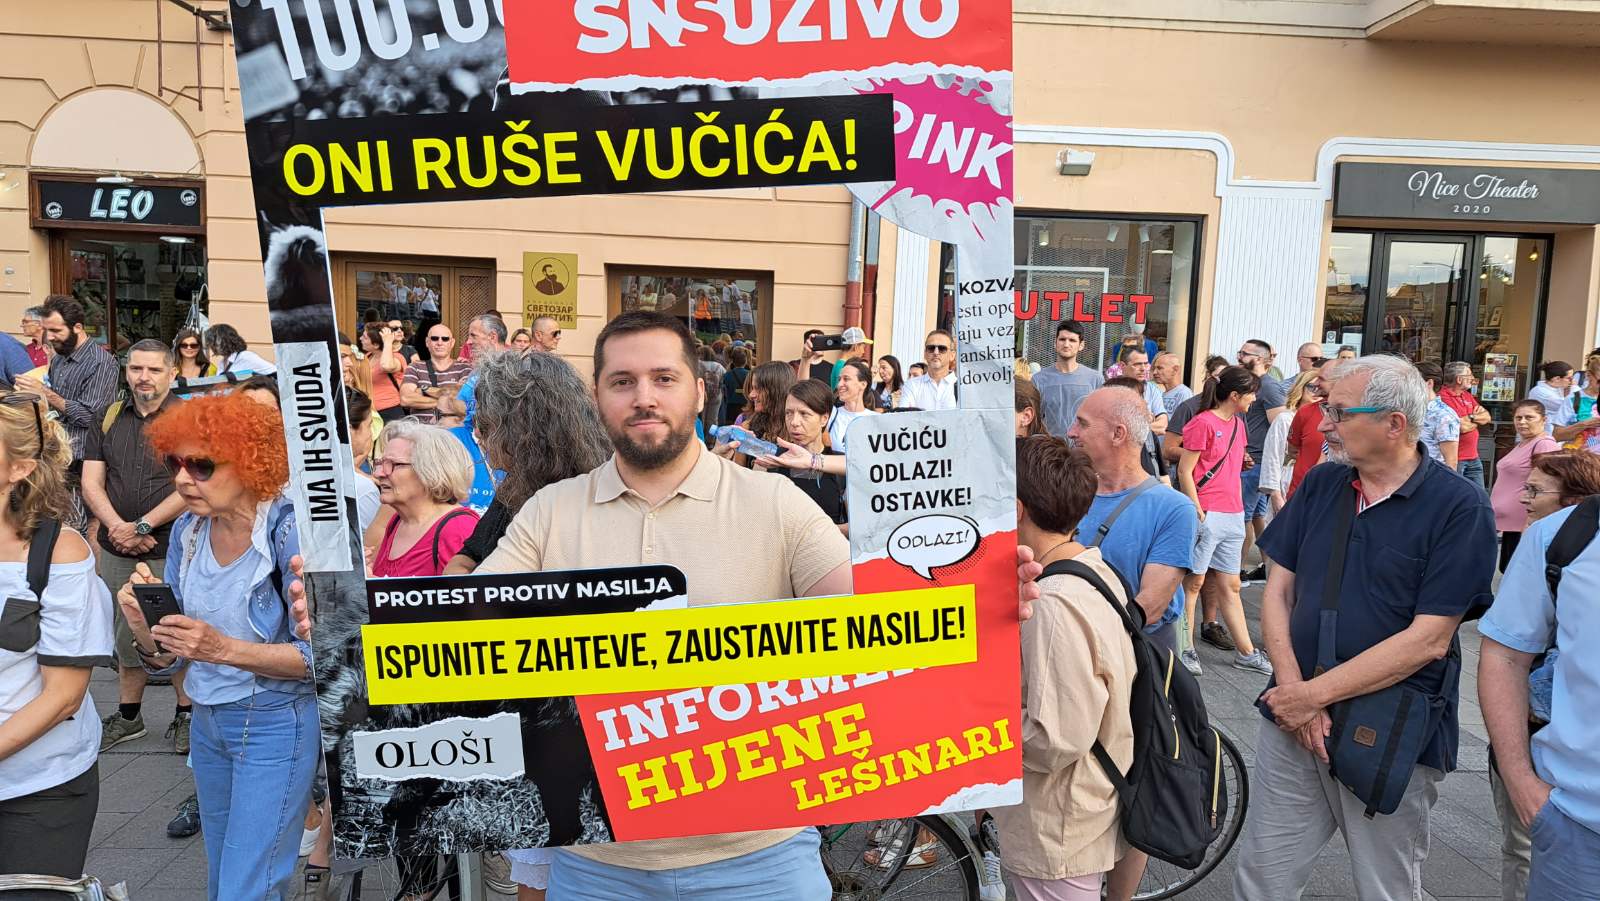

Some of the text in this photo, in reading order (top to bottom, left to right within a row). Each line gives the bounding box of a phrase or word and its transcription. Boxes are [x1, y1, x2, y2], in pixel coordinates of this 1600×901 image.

[283, 108, 858, 196] ONI RUŠE VUČIĆA!
[894, 100, 1014, 189] PINK
[1408, 170, 1540, 199] Nice Theater
[90, 188, 154, 220] LEO
[1454, 205, 1491, 213] 2020
[527, 304, 573, 314] СВЕТОЗАР
[1014, 290, 1154, 324] UTLET
[293, 363, 339, 521] IMA IH SVUDA
[868, 426, 947, 453] VUČIĆU
[870, 459, 952, 483] ODLAZI!
[871, 487, 972, 513] OSTAVKE!
[897, 529, 970, 550] ODLAZI!
[375, 576, 673, 608] PROTEST PROTIV NASILJA
[375, 606, 966, 680] ISPUNITE ZAHTEVE, ZAUSTAVITE NASILJE!
[375, 730, 496, 768] OLOŠI
[617, 703, 873, 810] HIJENE
[790, 718, 1015, 811] LEŠINARI
